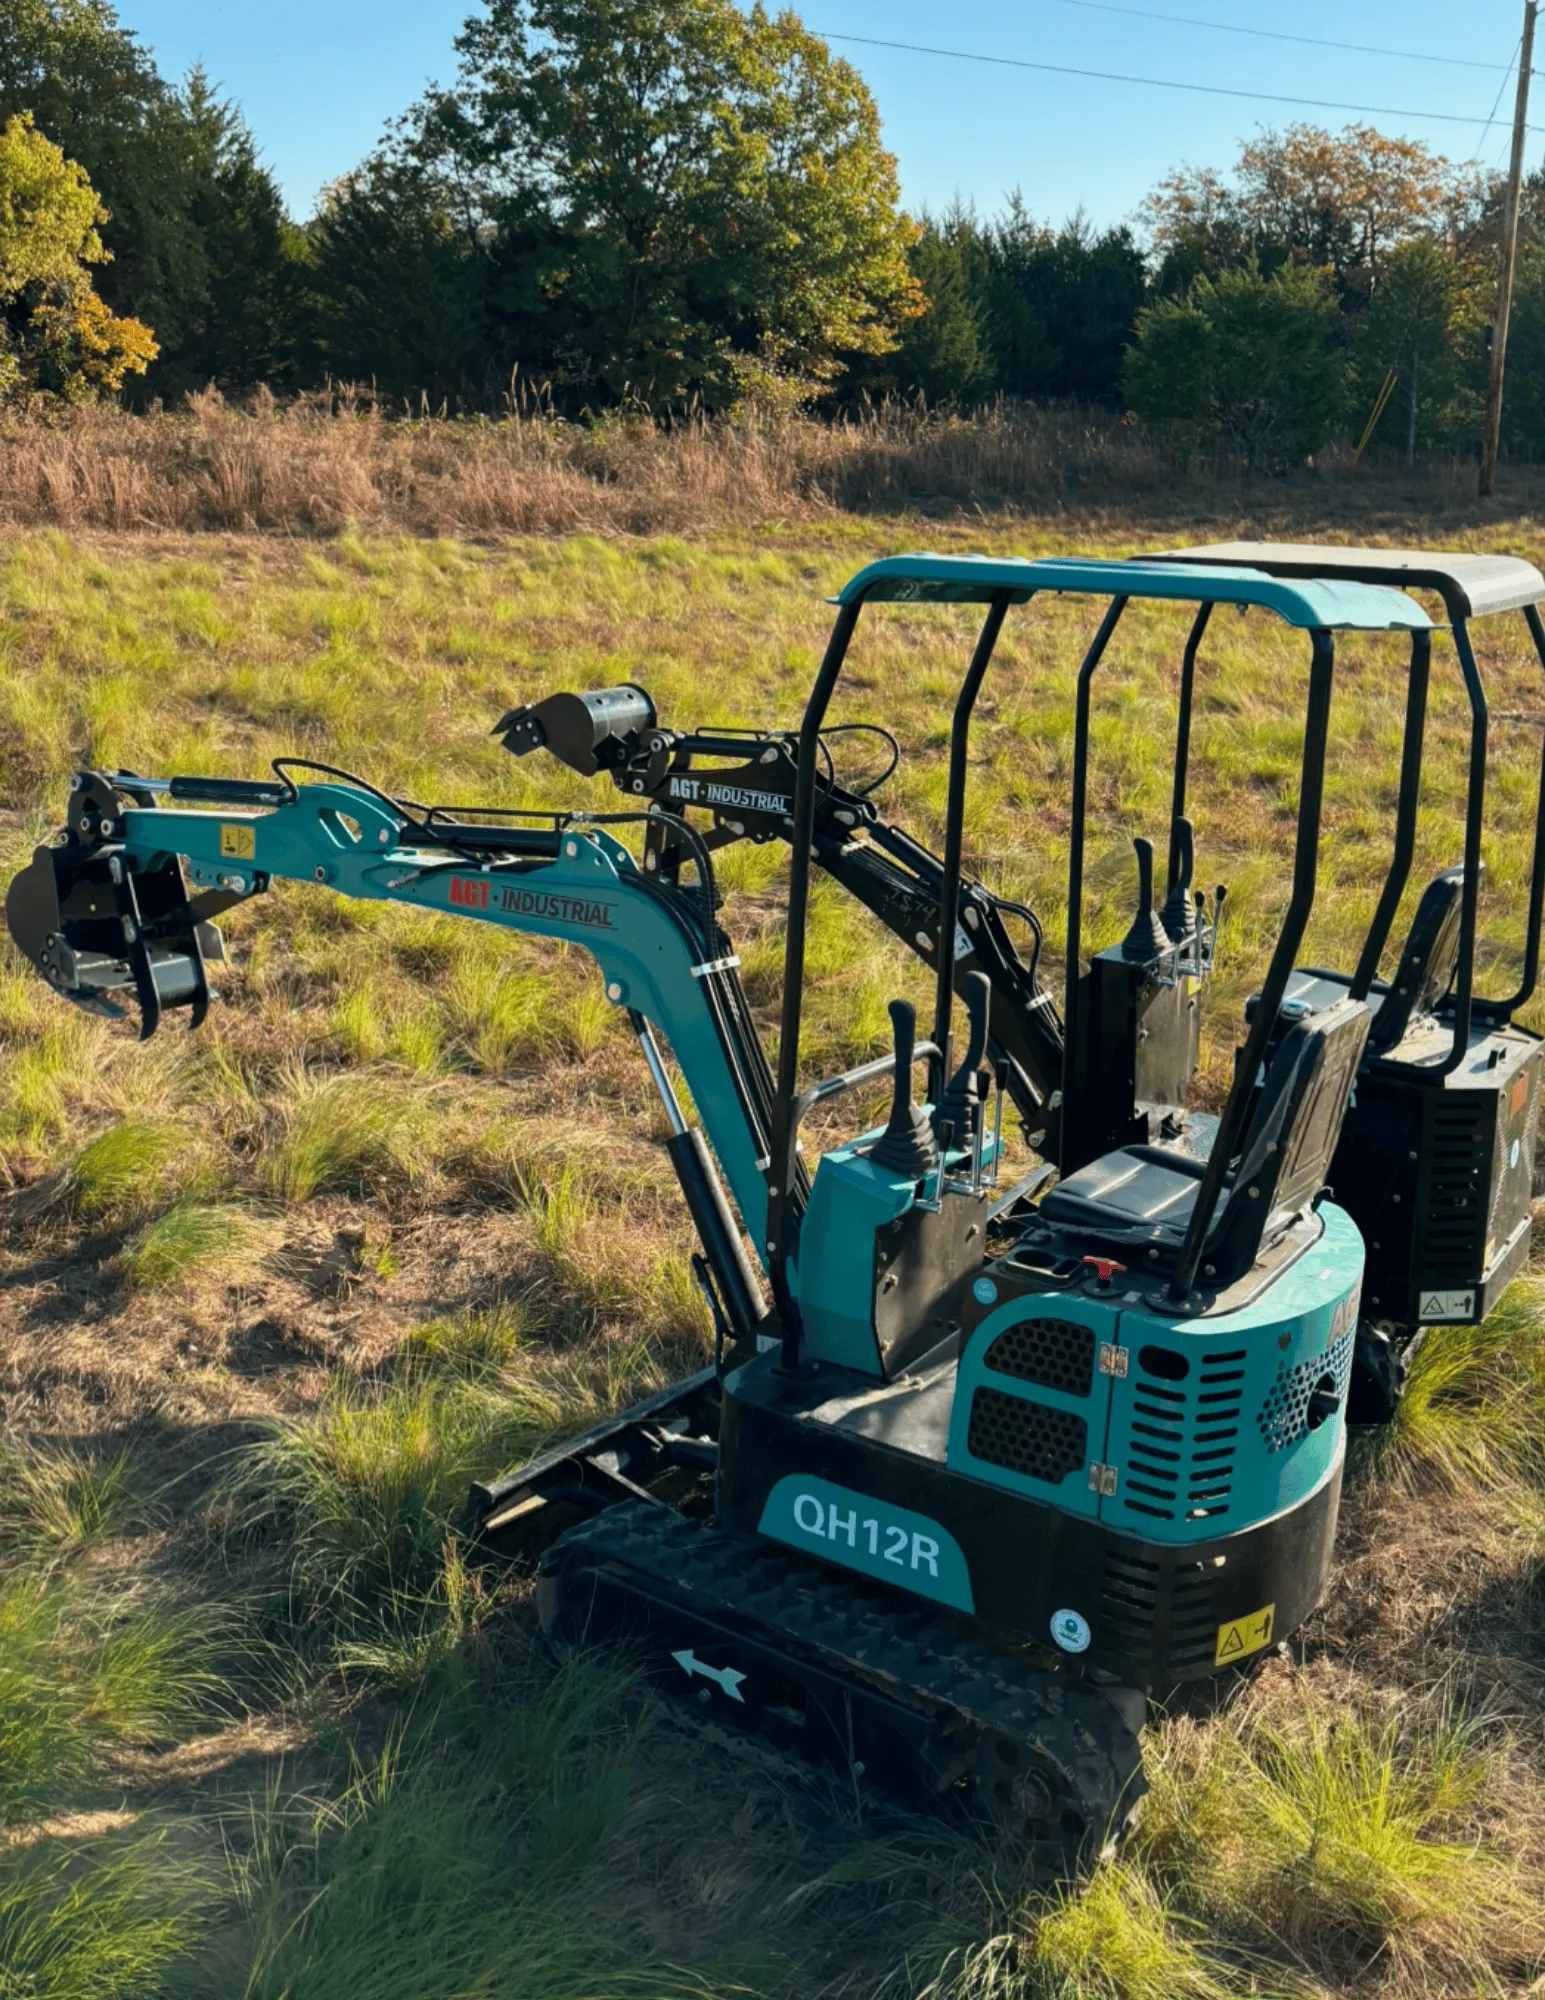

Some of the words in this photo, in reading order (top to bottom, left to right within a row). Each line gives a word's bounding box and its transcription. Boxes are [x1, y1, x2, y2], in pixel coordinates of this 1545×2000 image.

[670, 777, 700, 800] AGT
[707, 784, 788, 813] INDUSTRIAL
[449, 876, 491, 911] AGT
[501, 888, 613, 927] INDUSTRIAL
[793, 1493, 940, 1578] QH12R
